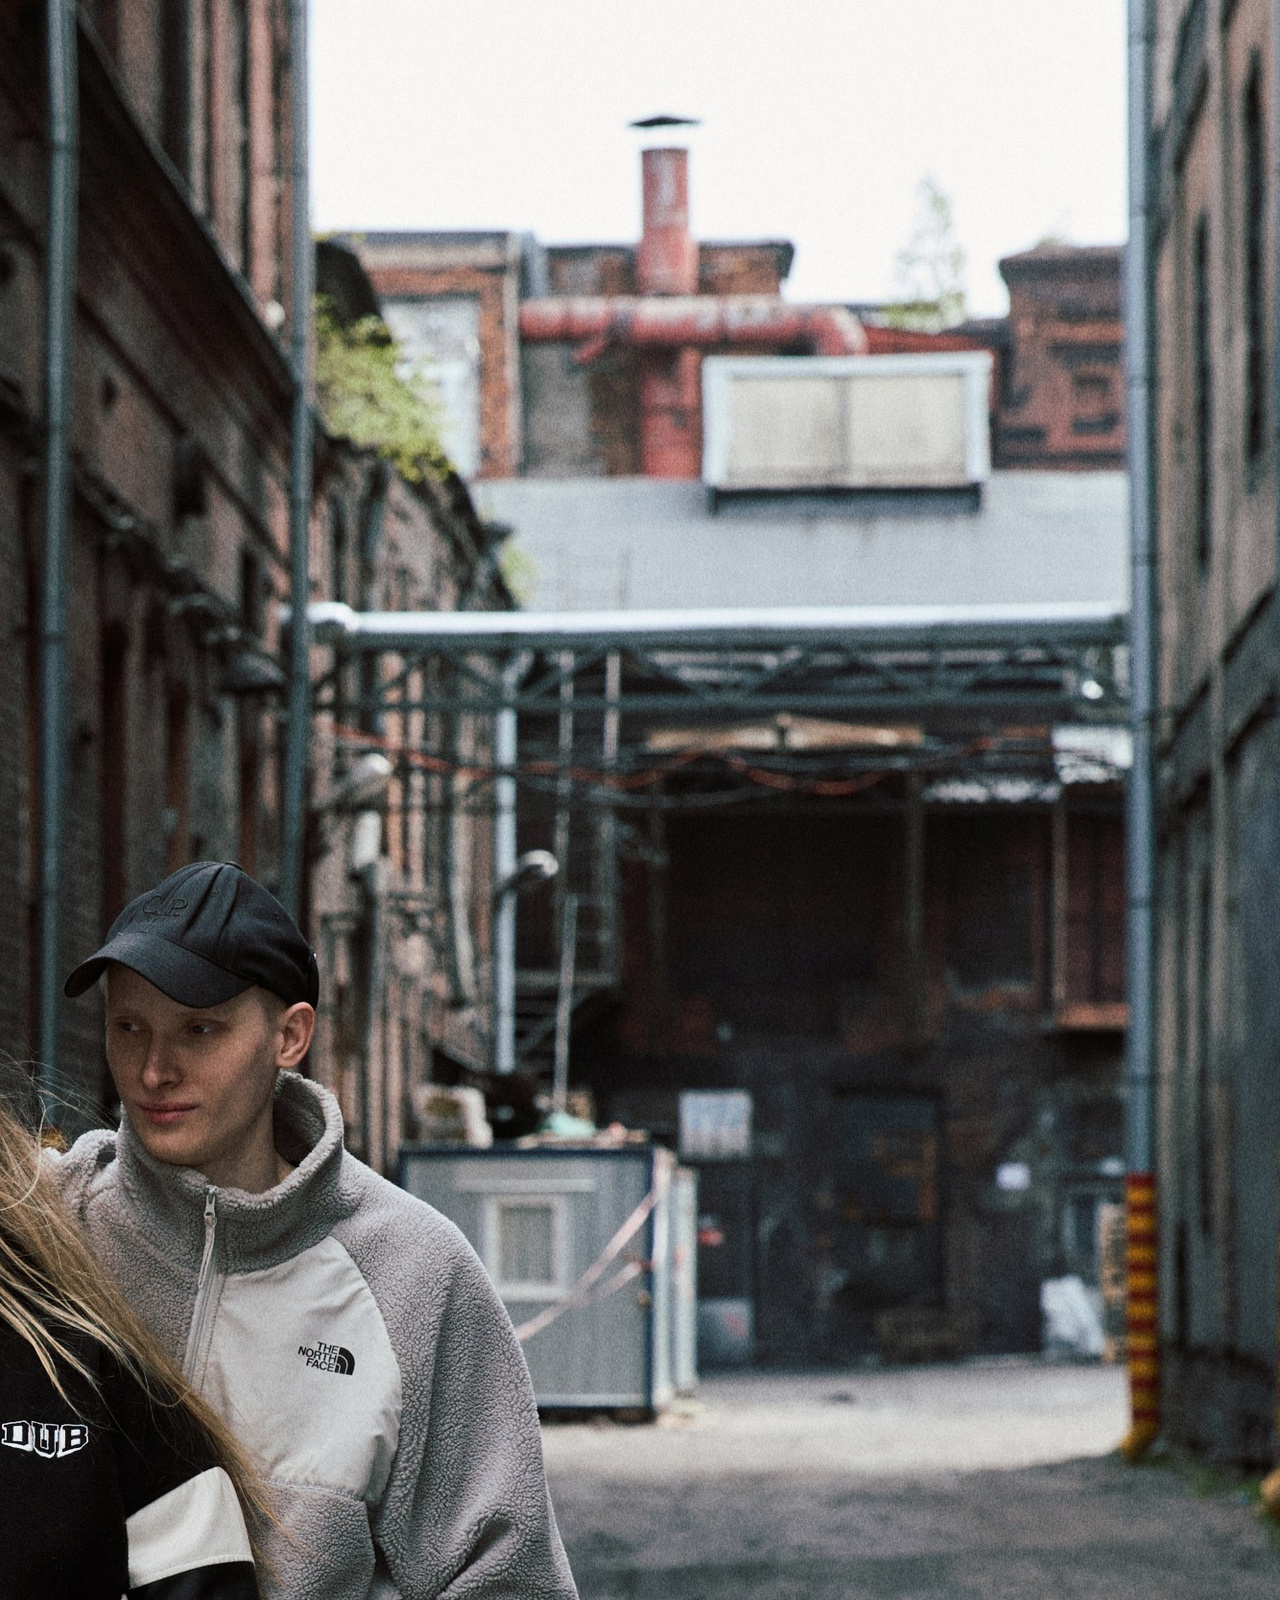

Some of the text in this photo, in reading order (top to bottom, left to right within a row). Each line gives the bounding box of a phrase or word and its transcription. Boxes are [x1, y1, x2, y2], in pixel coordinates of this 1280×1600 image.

[298, 1346, 337, 1363] NORTH
[317, 1341, 339, 1355] THE
[306, 1357, 335, 1373] FACE
[1, 1420, 88, 1459] DUB
